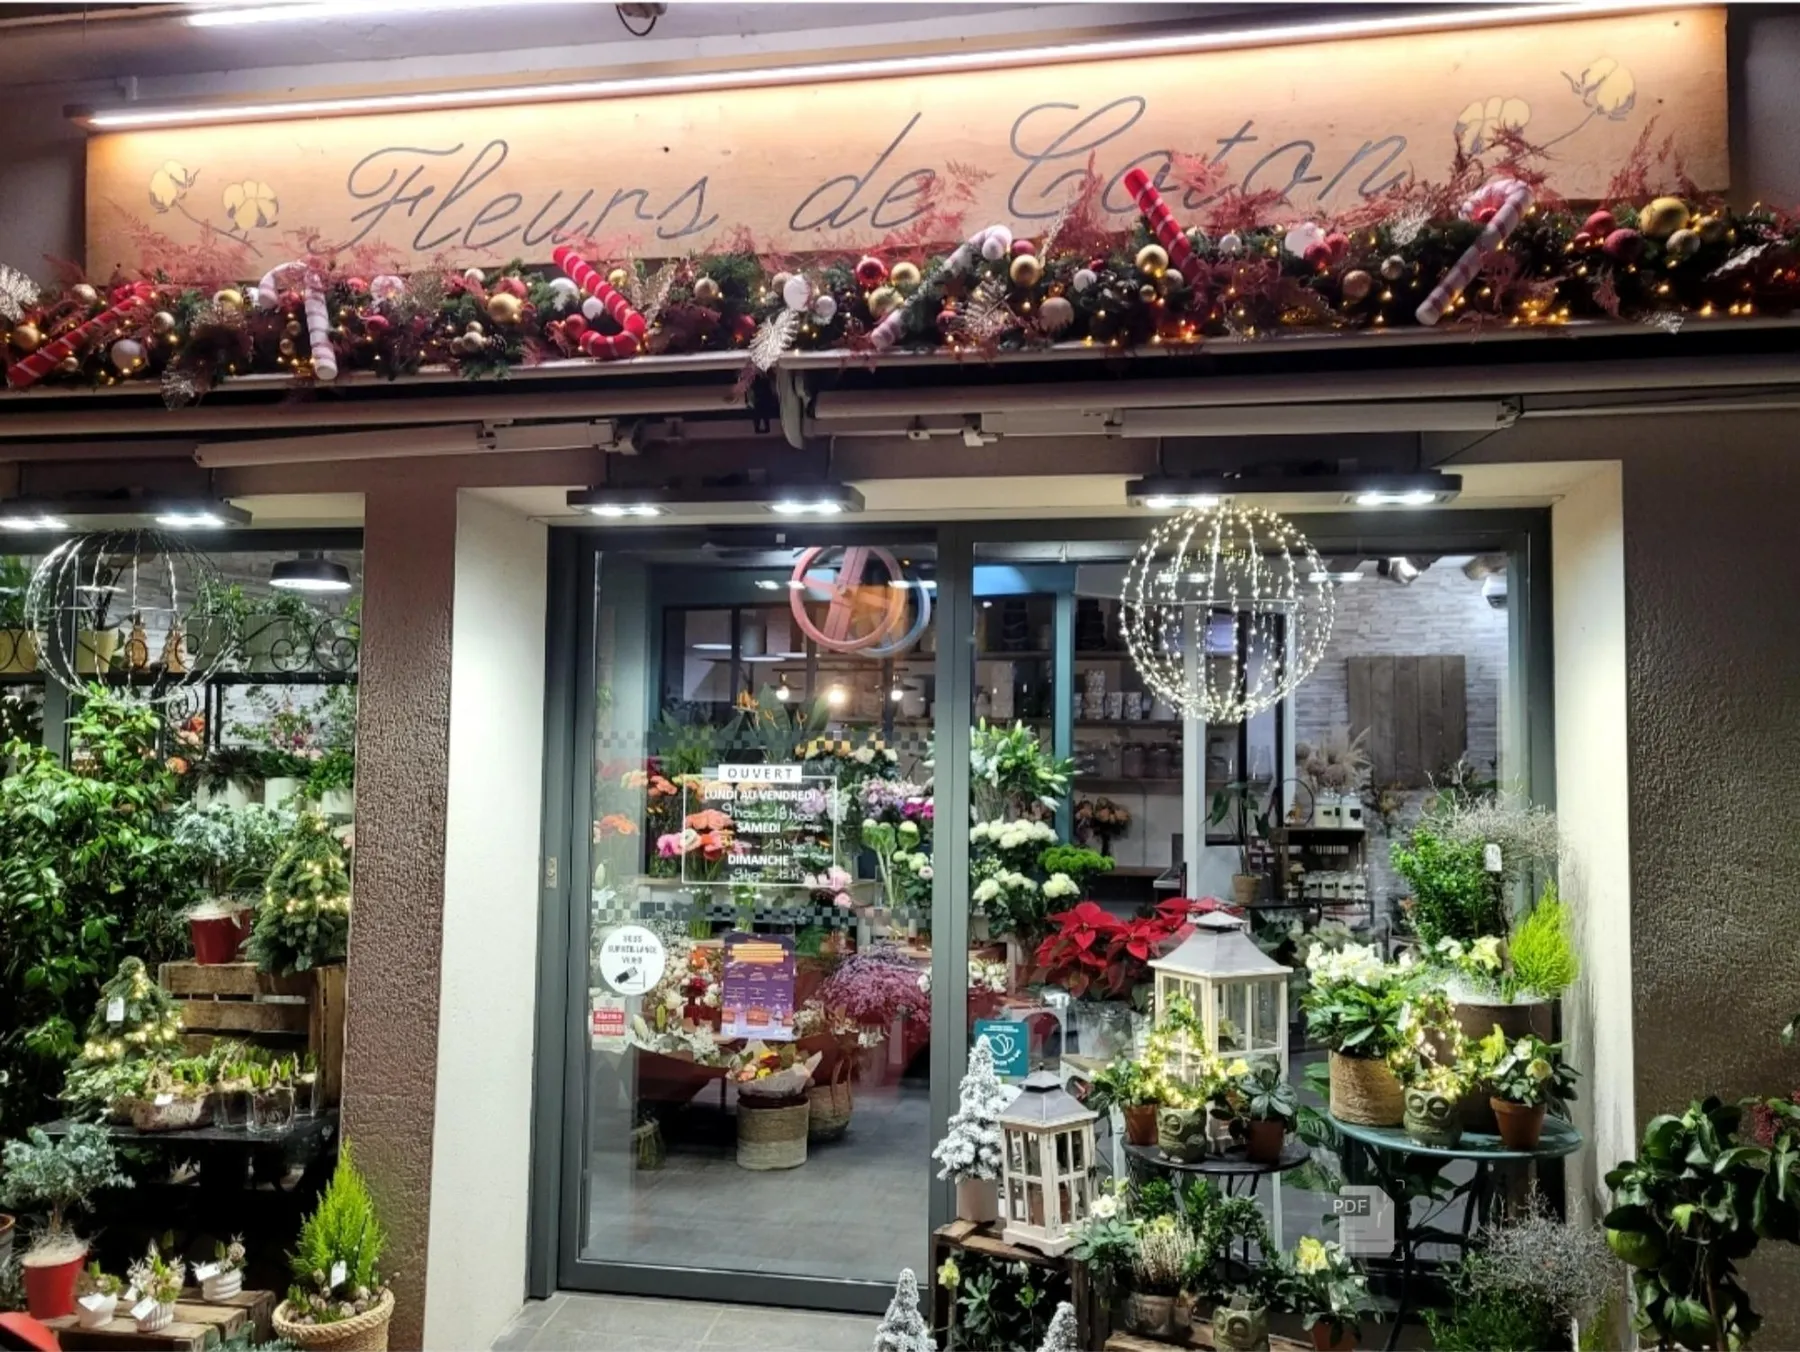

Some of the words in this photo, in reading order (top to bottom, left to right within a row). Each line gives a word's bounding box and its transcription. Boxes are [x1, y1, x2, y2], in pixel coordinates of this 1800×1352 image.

[307, 138, 720, 255] Fleurs
[787, 112, 938, 233] de
[1007, 96, 1408, 219] Coton
[727, 768, 793, 778] OUVERT
[704, 790, 738, 800] LUNDI
[740, 790, 756, 800] AU
[757, 790, 816, 801] VENDREDI
[737, 823, 781, 833] SAMEDI
[727, 855, 790, 865] DIMANCHE
